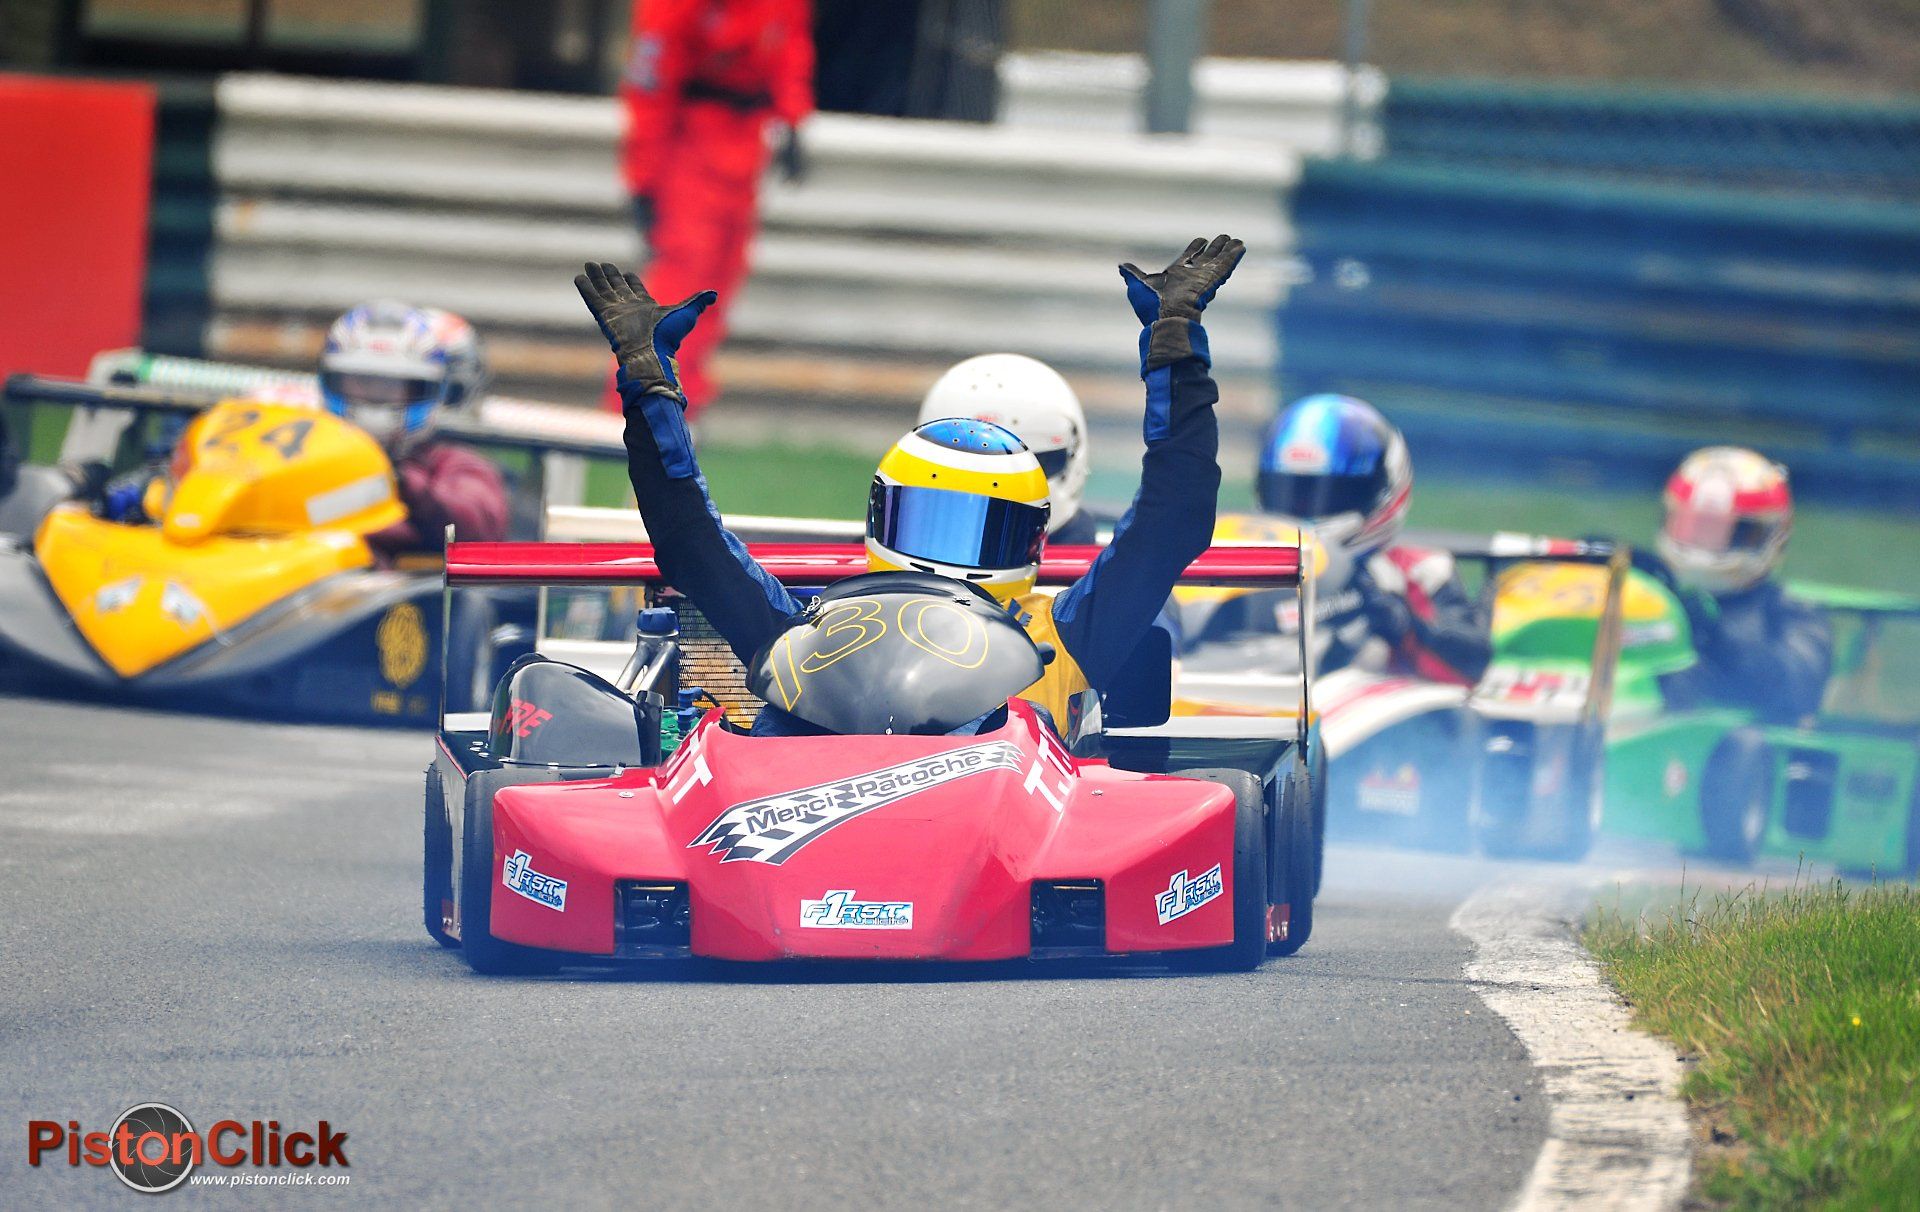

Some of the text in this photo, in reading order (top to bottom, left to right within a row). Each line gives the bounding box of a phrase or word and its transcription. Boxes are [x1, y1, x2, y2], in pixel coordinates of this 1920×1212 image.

[769, 599, 989, 712] 130
[744, 751, 983, 836] Merci Patoche
